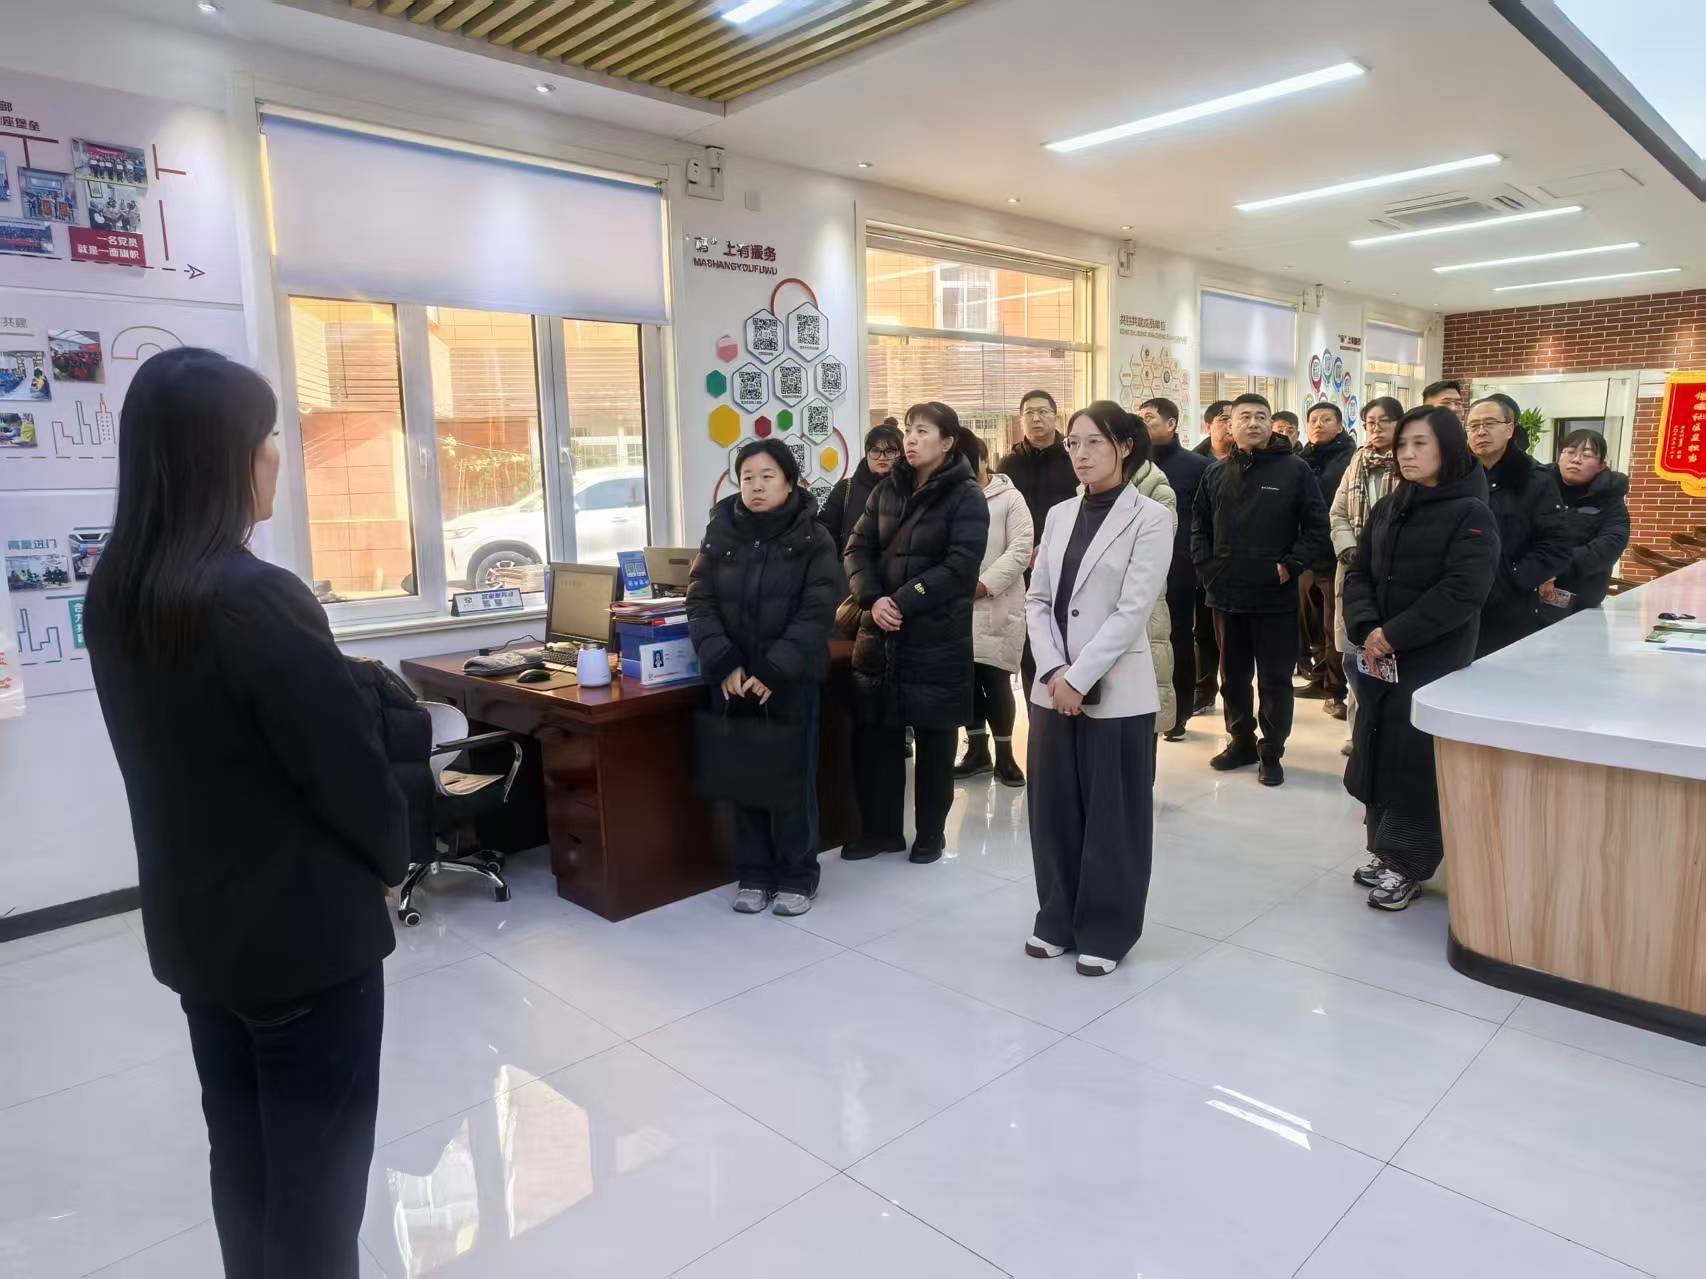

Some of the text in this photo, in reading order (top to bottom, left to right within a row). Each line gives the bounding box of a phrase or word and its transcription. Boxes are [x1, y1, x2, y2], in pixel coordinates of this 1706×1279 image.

[0, 116, 41, 132] 座堡垒
[693, 257, 778, 276] MASHANGYOUFUWU
